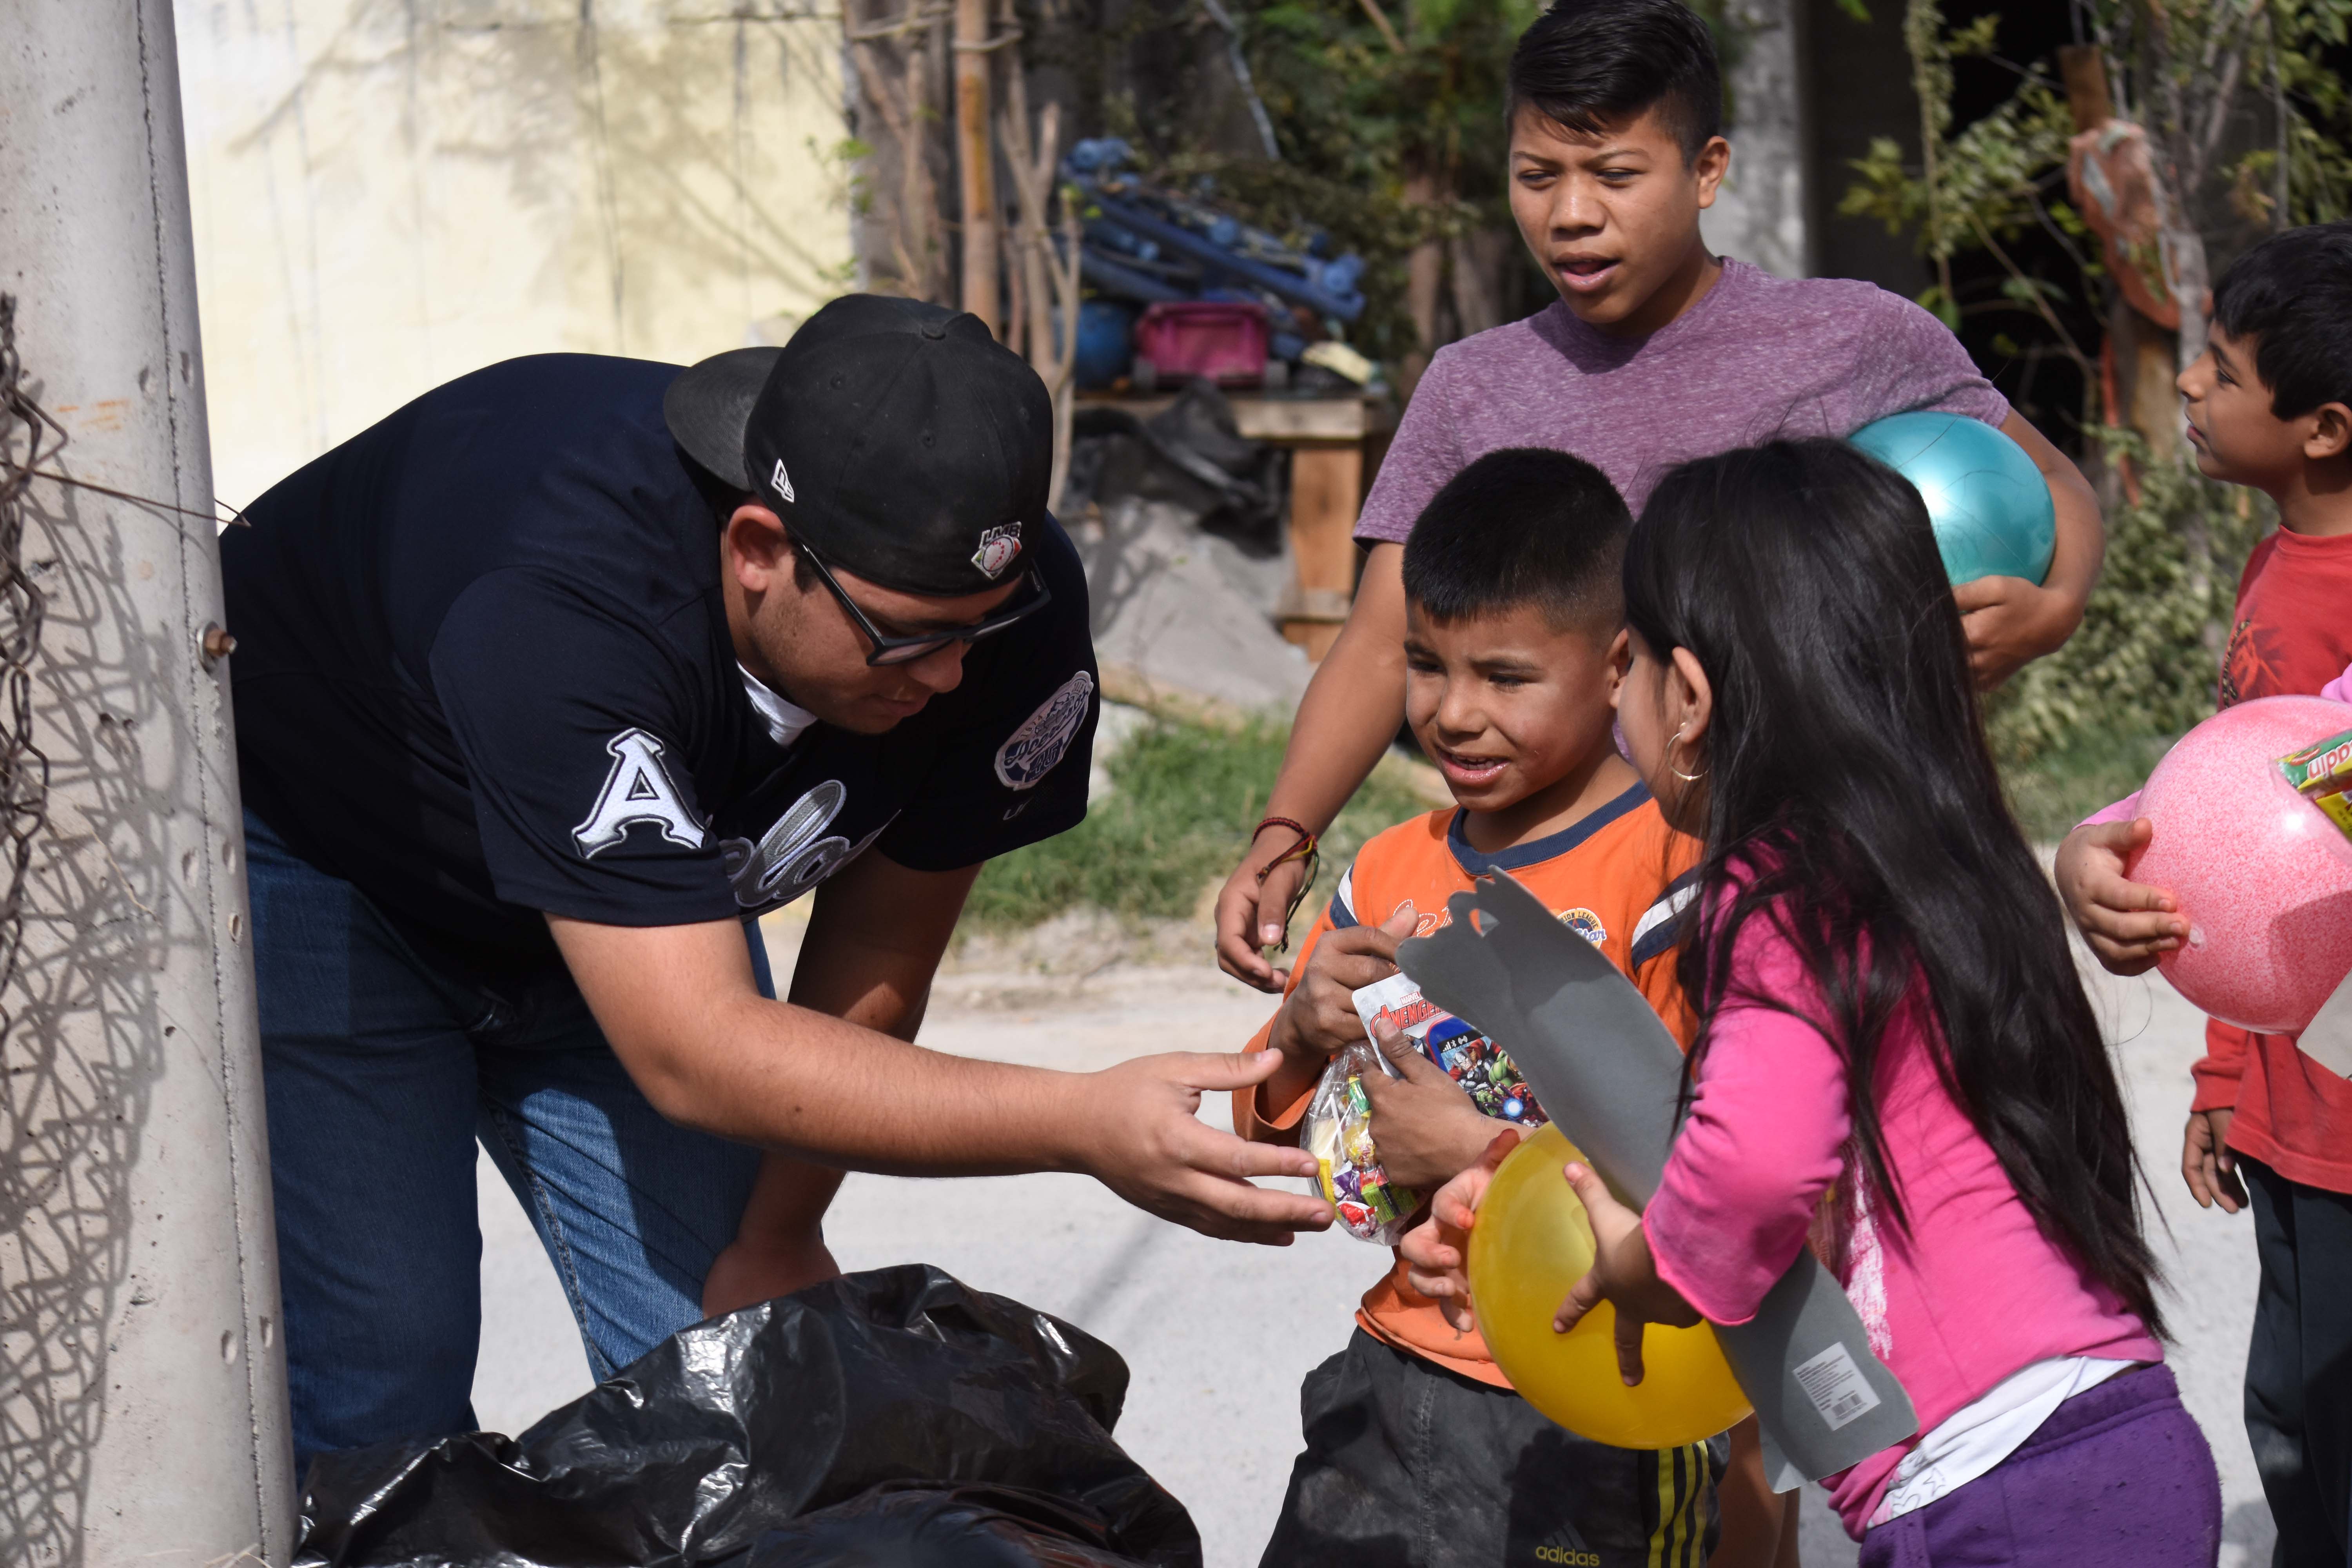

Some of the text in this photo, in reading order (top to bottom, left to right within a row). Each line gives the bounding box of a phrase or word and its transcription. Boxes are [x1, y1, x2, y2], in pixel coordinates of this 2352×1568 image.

[572, 727, 706, 859] A
[1578, 911, 1599, 929] LEAGUE
[1400, 992, 1421, 1005] MARVEL
[1535, 1546, 1600, 1567] adidas
